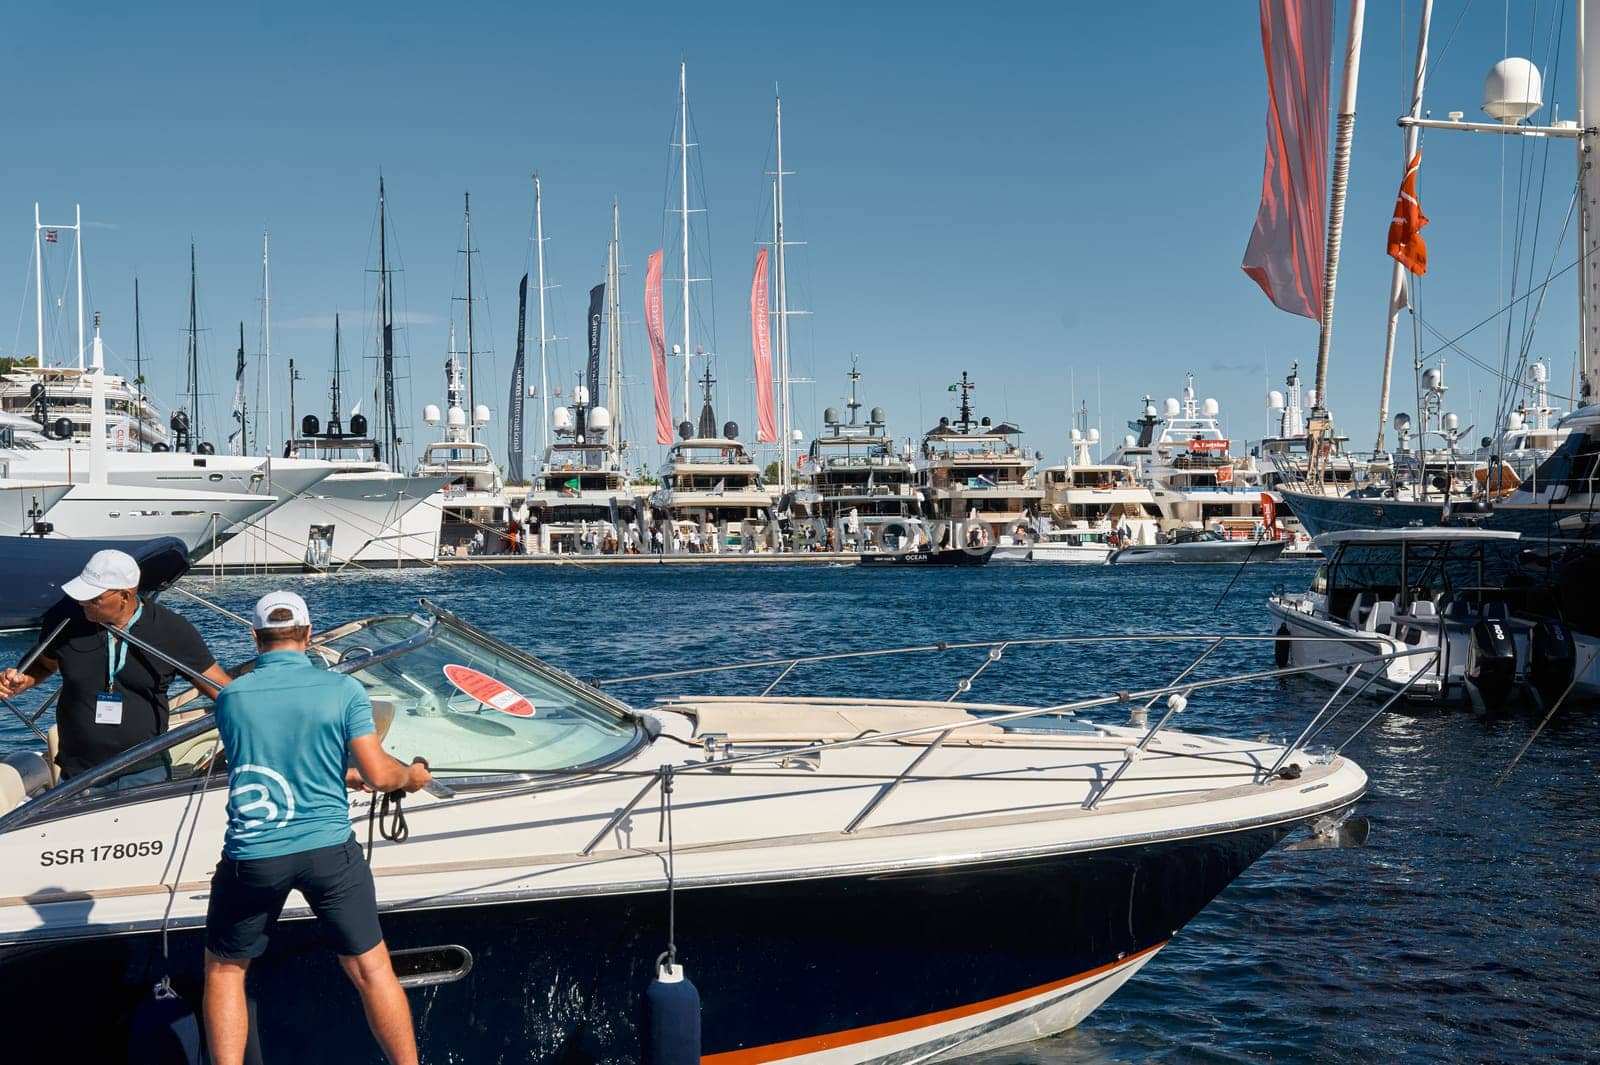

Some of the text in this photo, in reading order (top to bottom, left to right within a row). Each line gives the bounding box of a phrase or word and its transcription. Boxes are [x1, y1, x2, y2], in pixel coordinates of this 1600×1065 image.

[513, 396, 522, 453] International
[40, 840, 164, 867] SSR 178059
